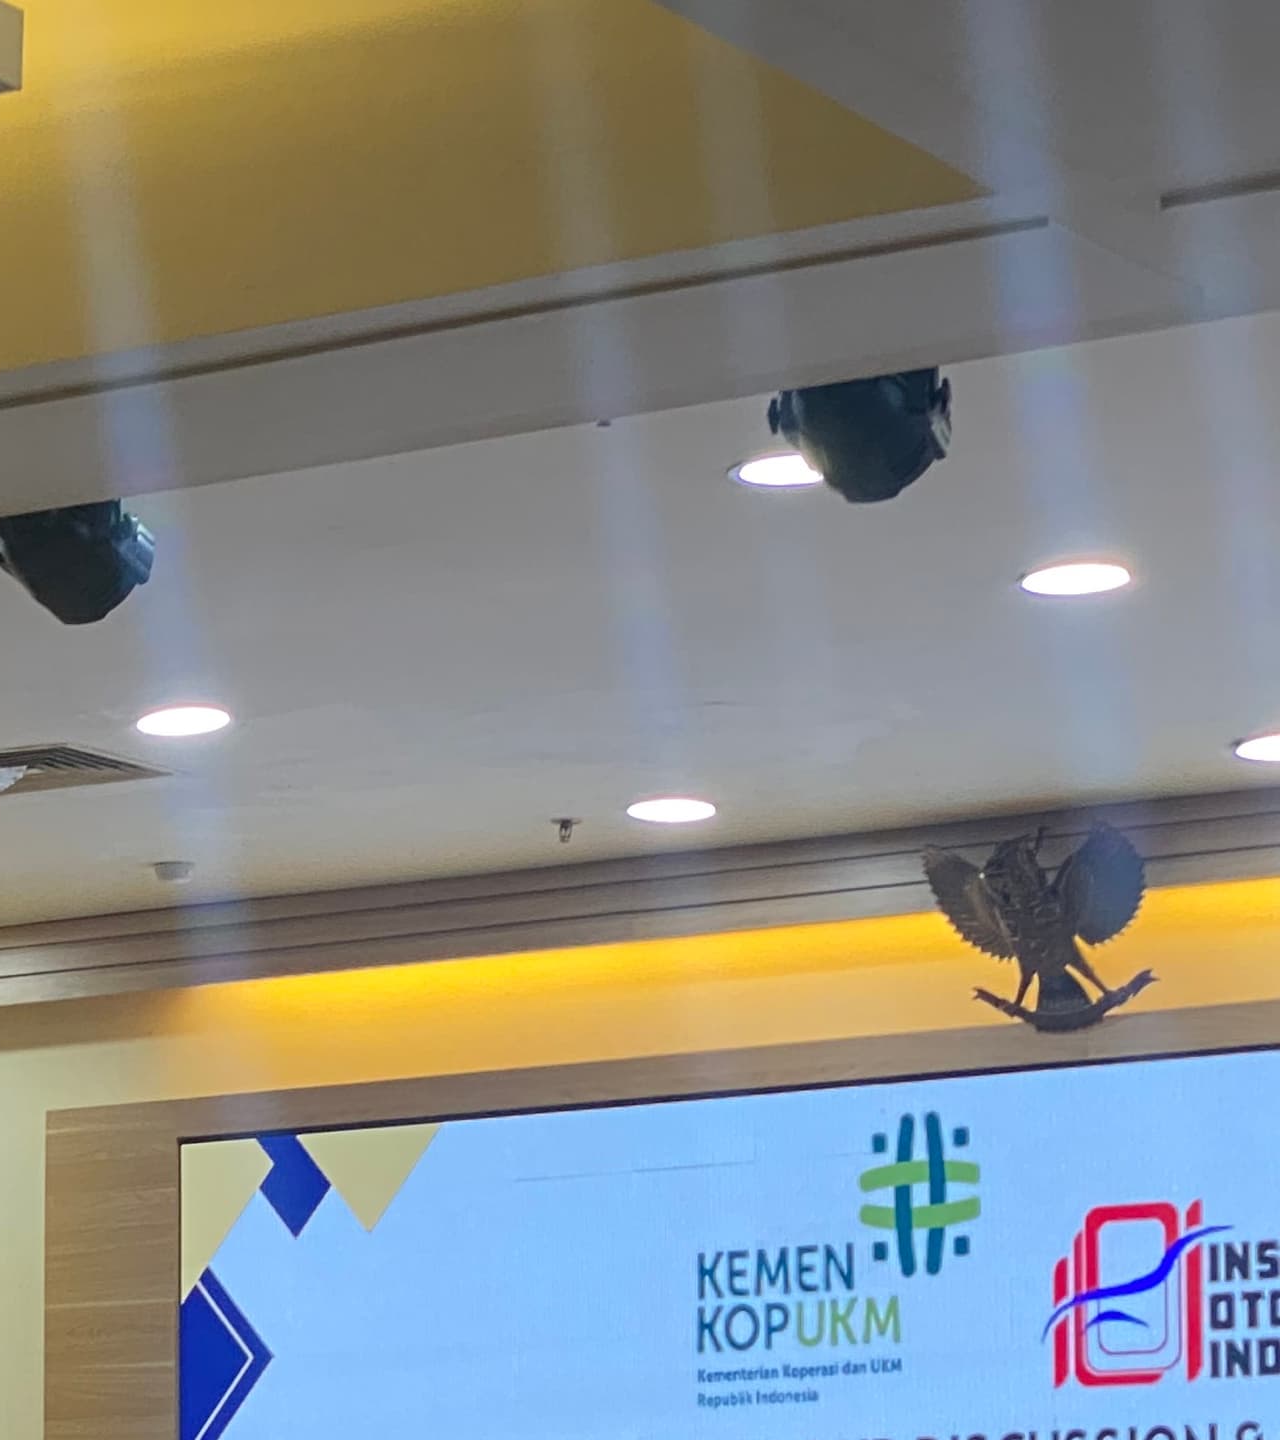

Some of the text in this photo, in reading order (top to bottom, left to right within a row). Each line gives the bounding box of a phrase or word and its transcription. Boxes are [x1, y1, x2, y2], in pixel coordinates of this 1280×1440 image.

[697, 1242, 854, 1299] KEMEN
[1209, 1240, 1279, 1282] INS
[697, 1295, 901, 1354] KOPUKM
[870, 1358, 903, 1374] UKM
